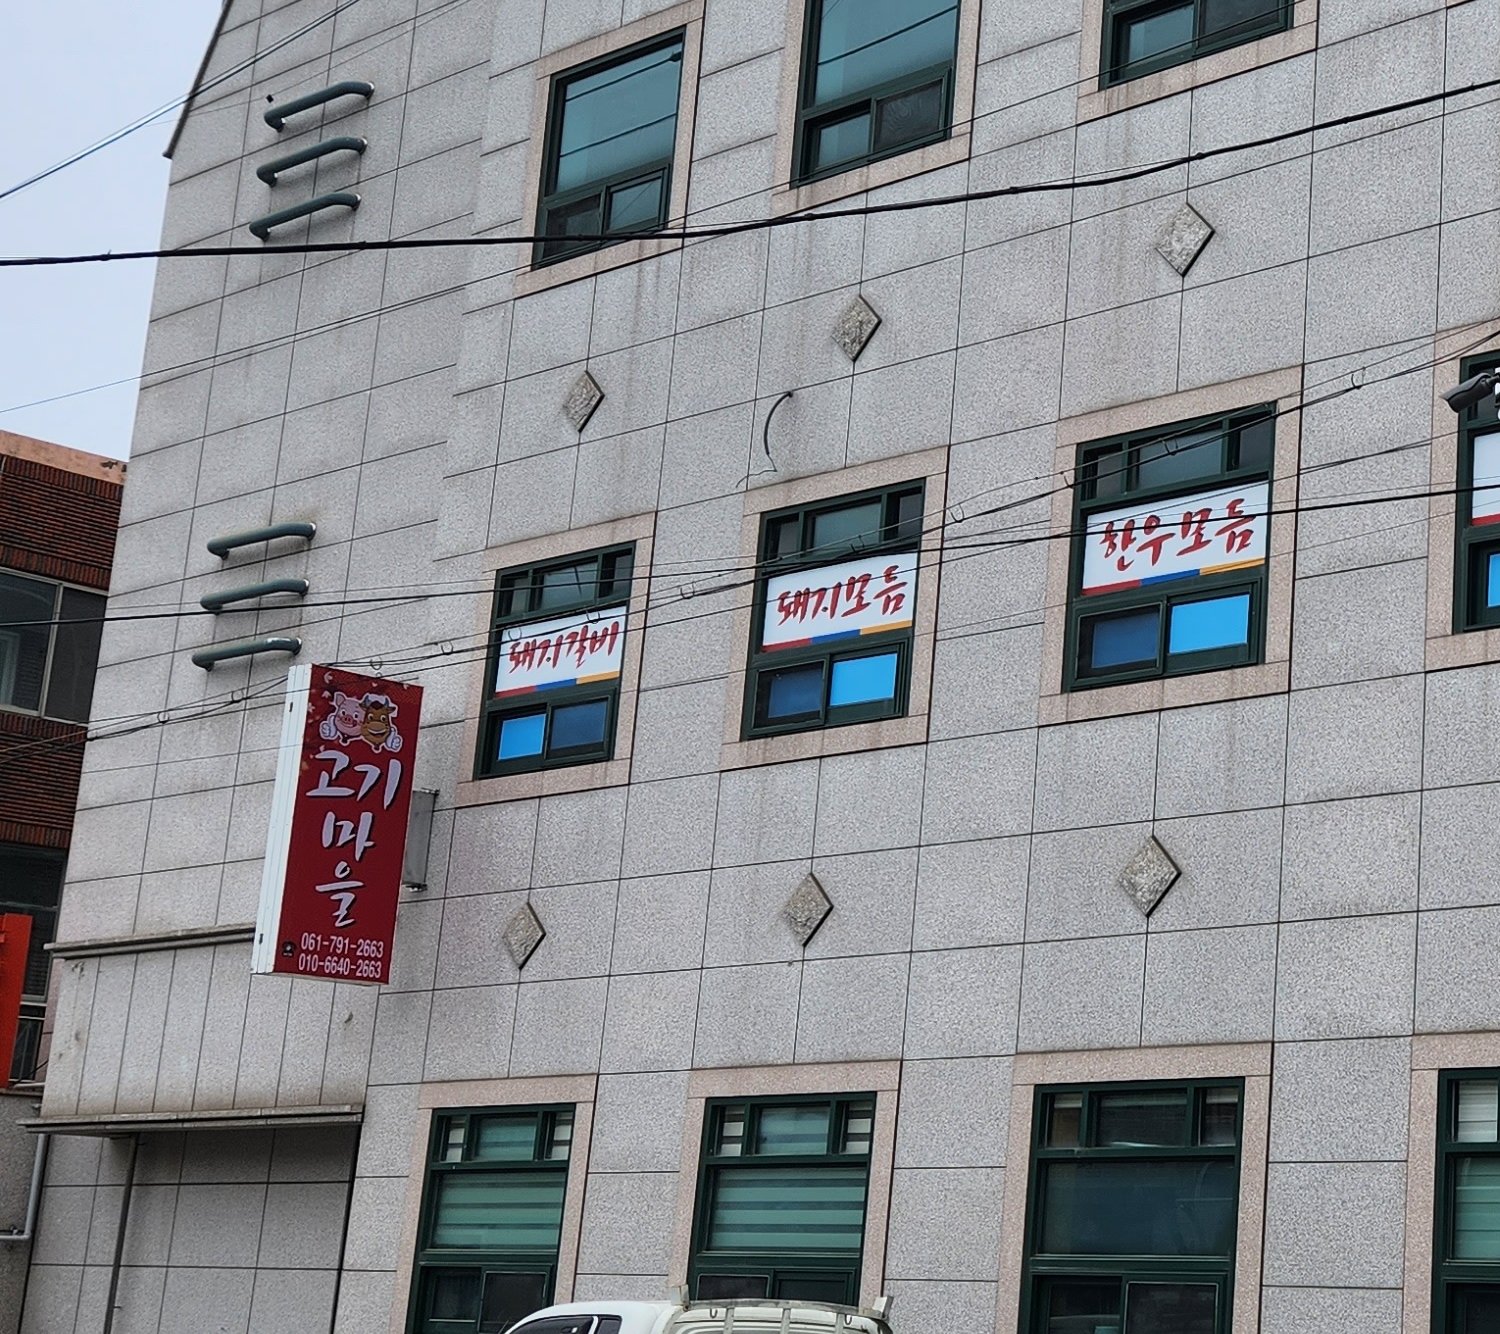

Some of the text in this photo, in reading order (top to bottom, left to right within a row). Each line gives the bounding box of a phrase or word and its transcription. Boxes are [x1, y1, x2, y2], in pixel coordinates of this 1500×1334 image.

[1099, 498, 1257, 572] 한우모듬
[776, 564, 909, 627] 돼지모듬
[508, 620, 620, 674] 돼지갈비
[305, 750, 403, 928] 고기마을
[298, 953, 383, 979] 010-6640-2663
[300, 932, 385, 958] 061-791-2663
